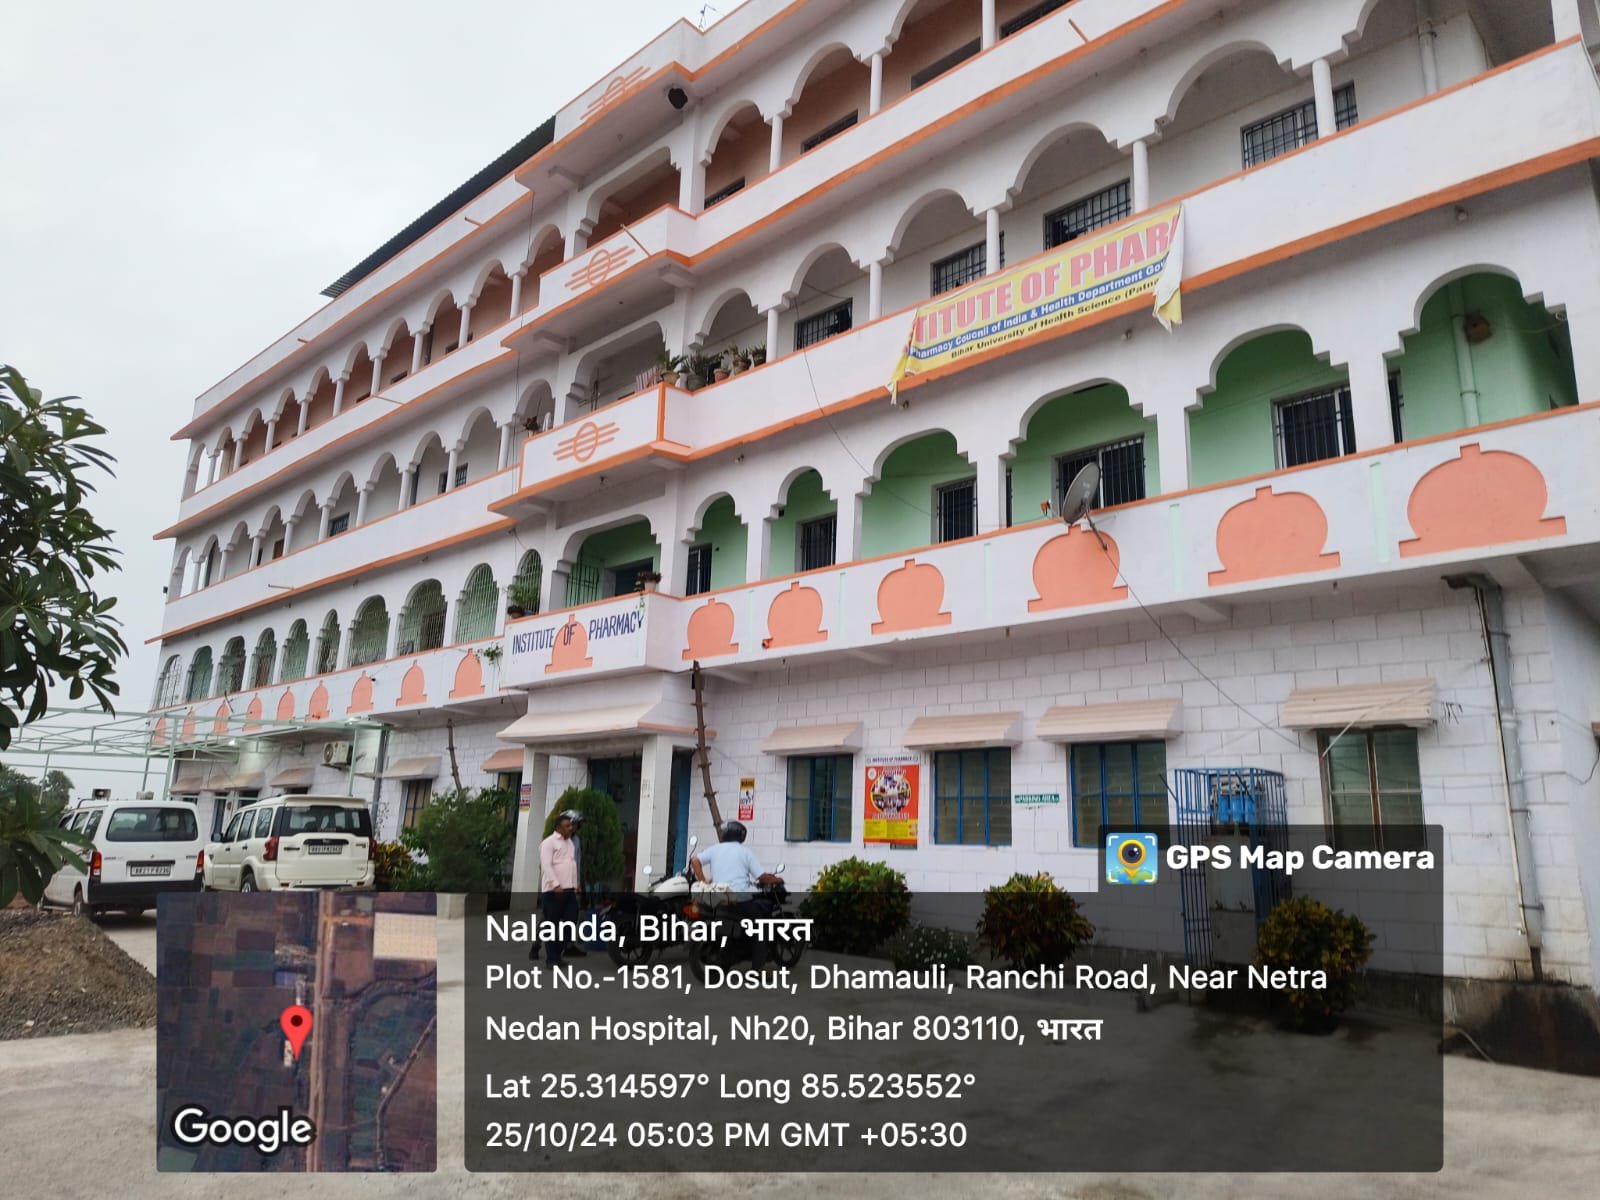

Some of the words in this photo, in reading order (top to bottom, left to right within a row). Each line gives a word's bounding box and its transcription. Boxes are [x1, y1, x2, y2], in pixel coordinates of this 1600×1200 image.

[991, 322, 1001, 333] of
[1003, 314, 1028, 329] India
[1030, 311, 1038, 319] &
[1041, 295, 1075, 314] Health
[1078, 271, 1143, 301] Department
[1020, 262, 1061, 305] OF
[951, 345, 974, 359] Bihar
[977, 328, 1026, 349] University
[1028, 322, 1037, 332] of
[1040, 310, 1074, 327] Health
[1077, 294, 1121, 314] Science
[512, 627, 555, 655] INSTITUTE
[563, 624, 577, 645] OF
[589, 610, 643, 640] PHARMACY
